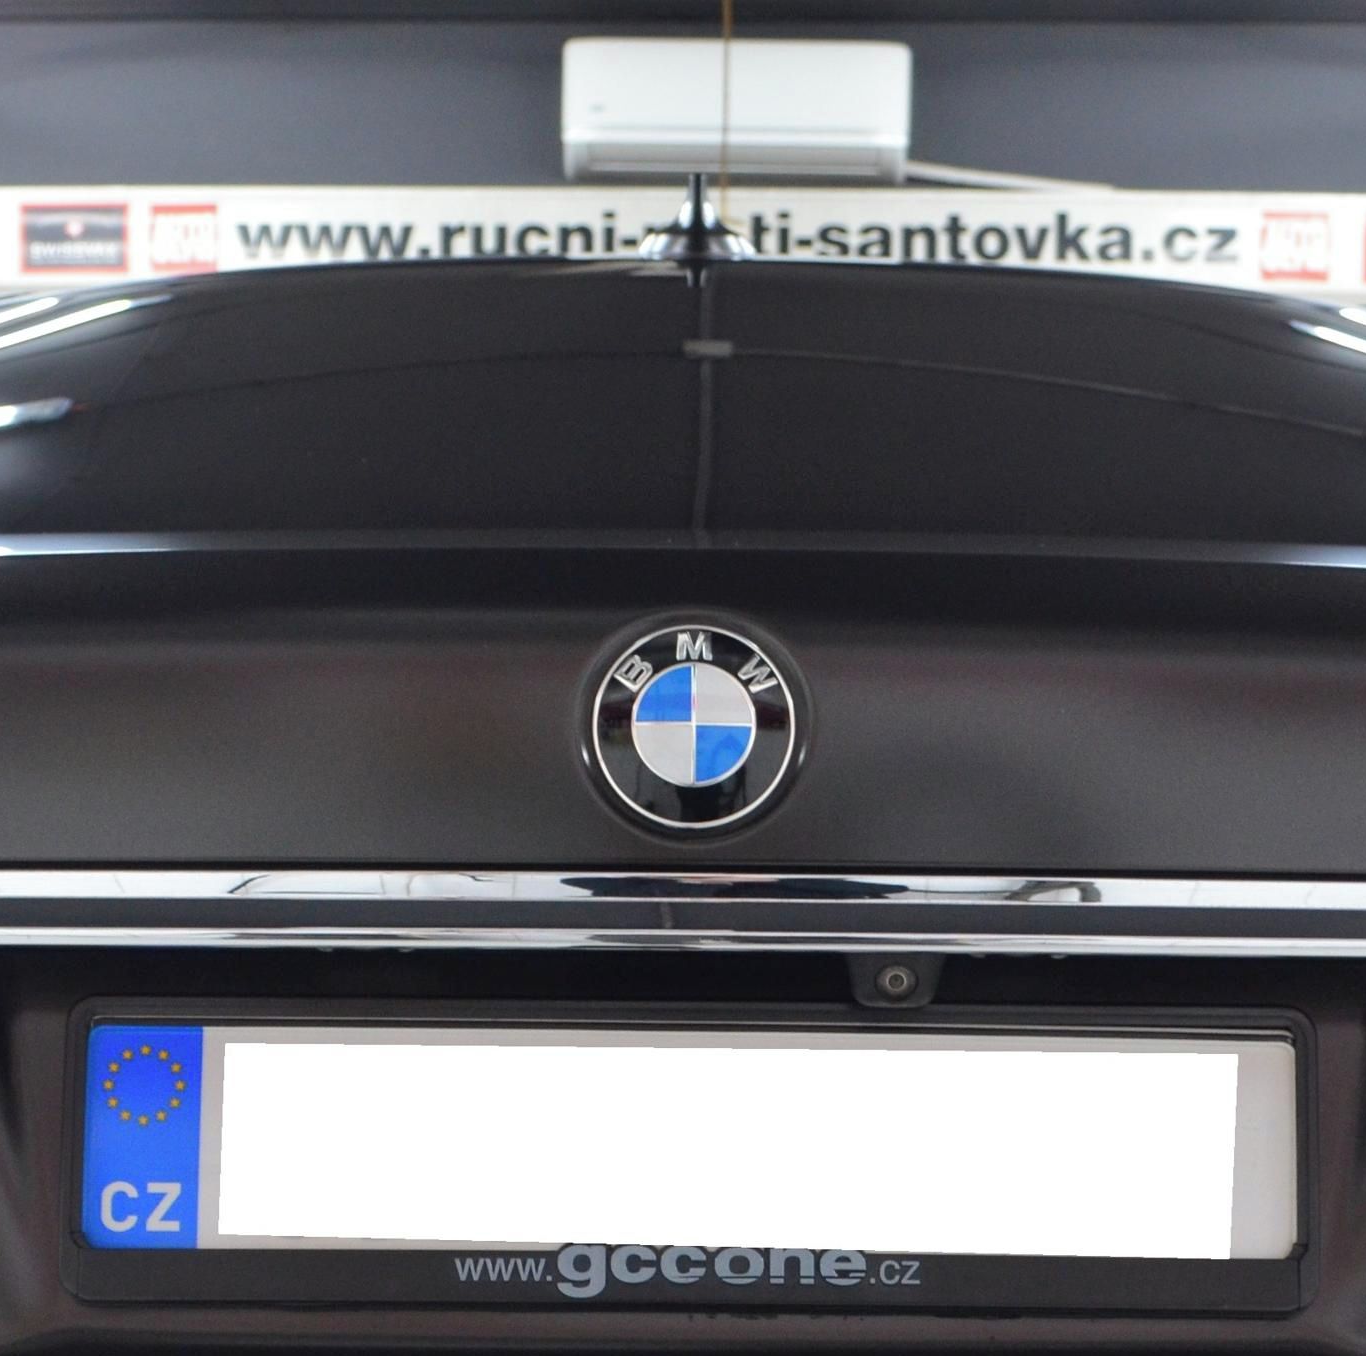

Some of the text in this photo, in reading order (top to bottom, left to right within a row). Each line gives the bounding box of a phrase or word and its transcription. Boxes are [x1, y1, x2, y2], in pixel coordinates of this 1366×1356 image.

[237, 210, 1240, 263] www.rucni-ti-santovka.cz
[614, 631, 778, 694] BMW
[99, 1180, 183, 1233] CZ
[454, 1243, 922, 1299] www.gccone.cz
